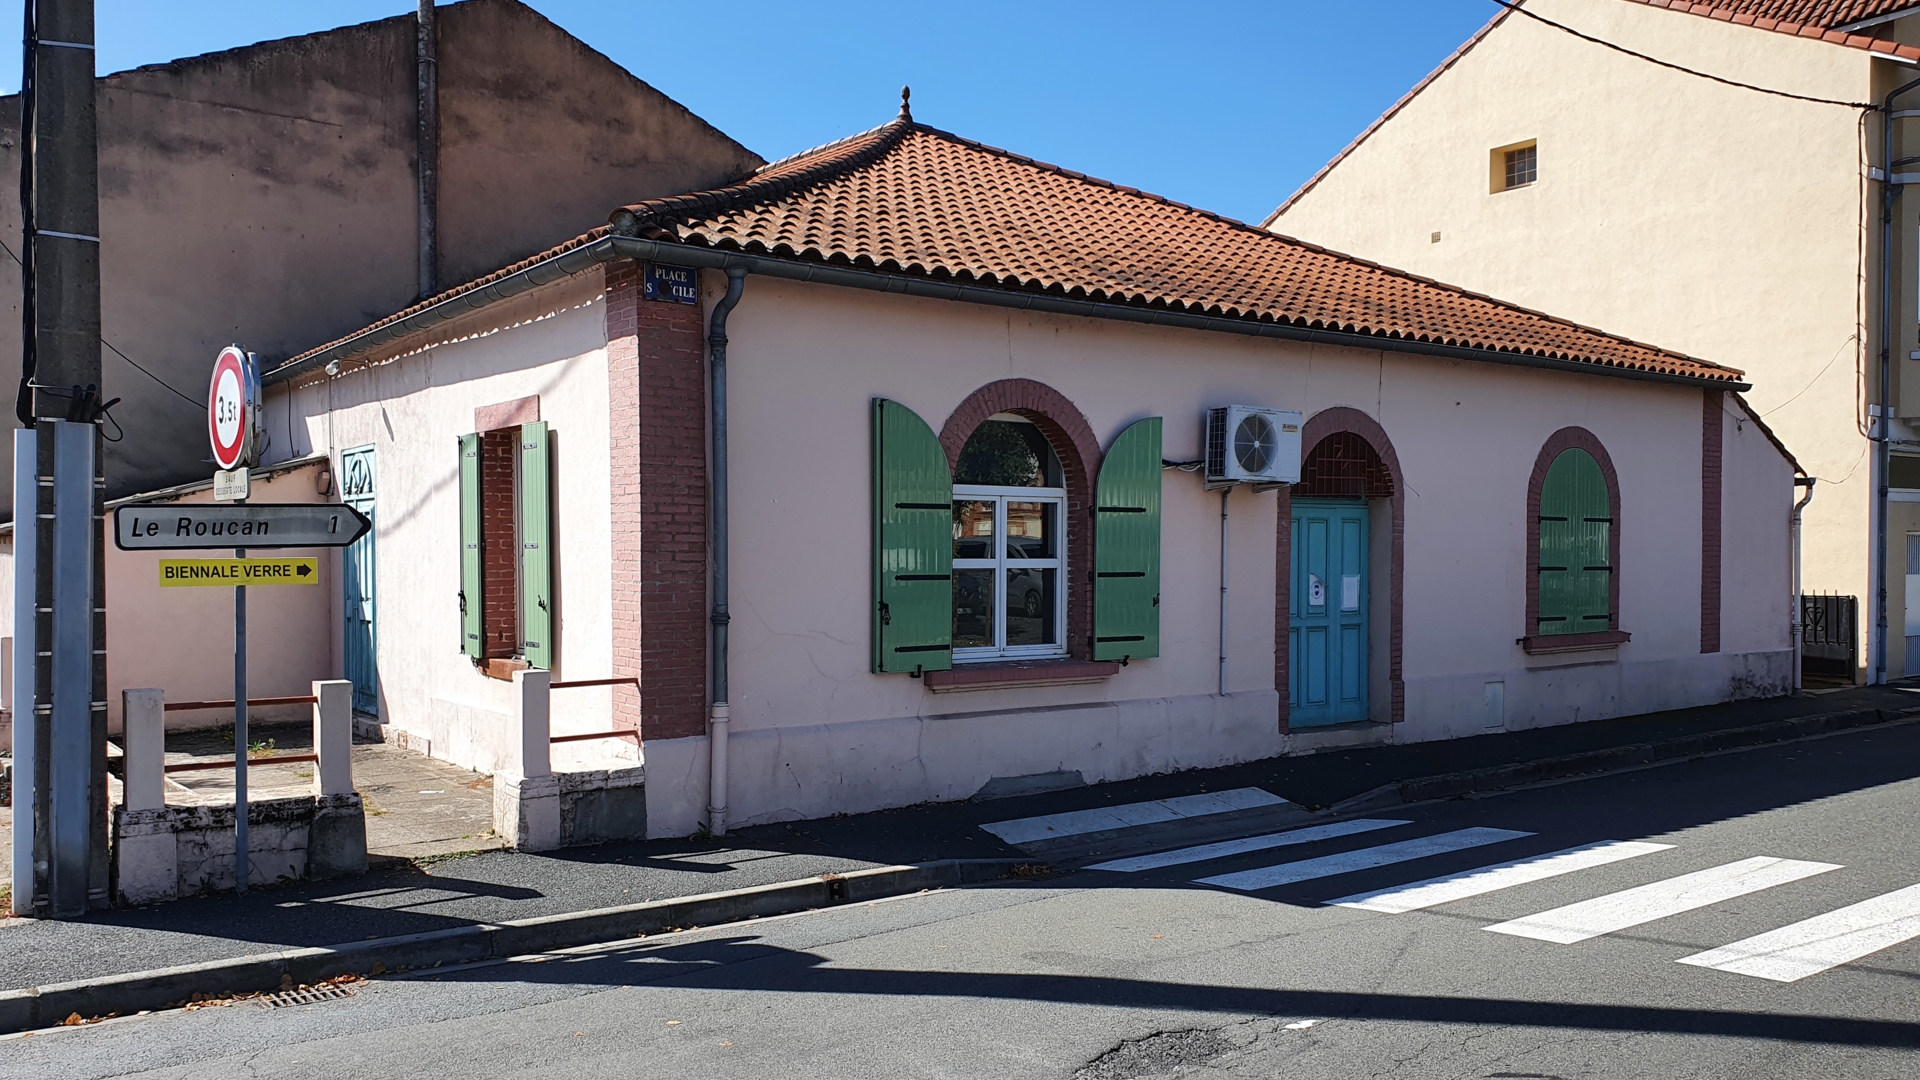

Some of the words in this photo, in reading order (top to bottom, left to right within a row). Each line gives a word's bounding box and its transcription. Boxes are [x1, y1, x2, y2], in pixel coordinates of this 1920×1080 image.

[655, 268, 687, 282] PLACE
[646, 282, 653, 292] S
[665, 281, 695, 298] CILE
[218, 396, 237, 424] 3,5t
[131, 517, 159, 537] Le
[175, 517, 269, 537] Roucan
[330, 515, 338, 534] 1
[164, 566, 239, 579] BIENNALE
[243, 564, 291, 577] VERRE
